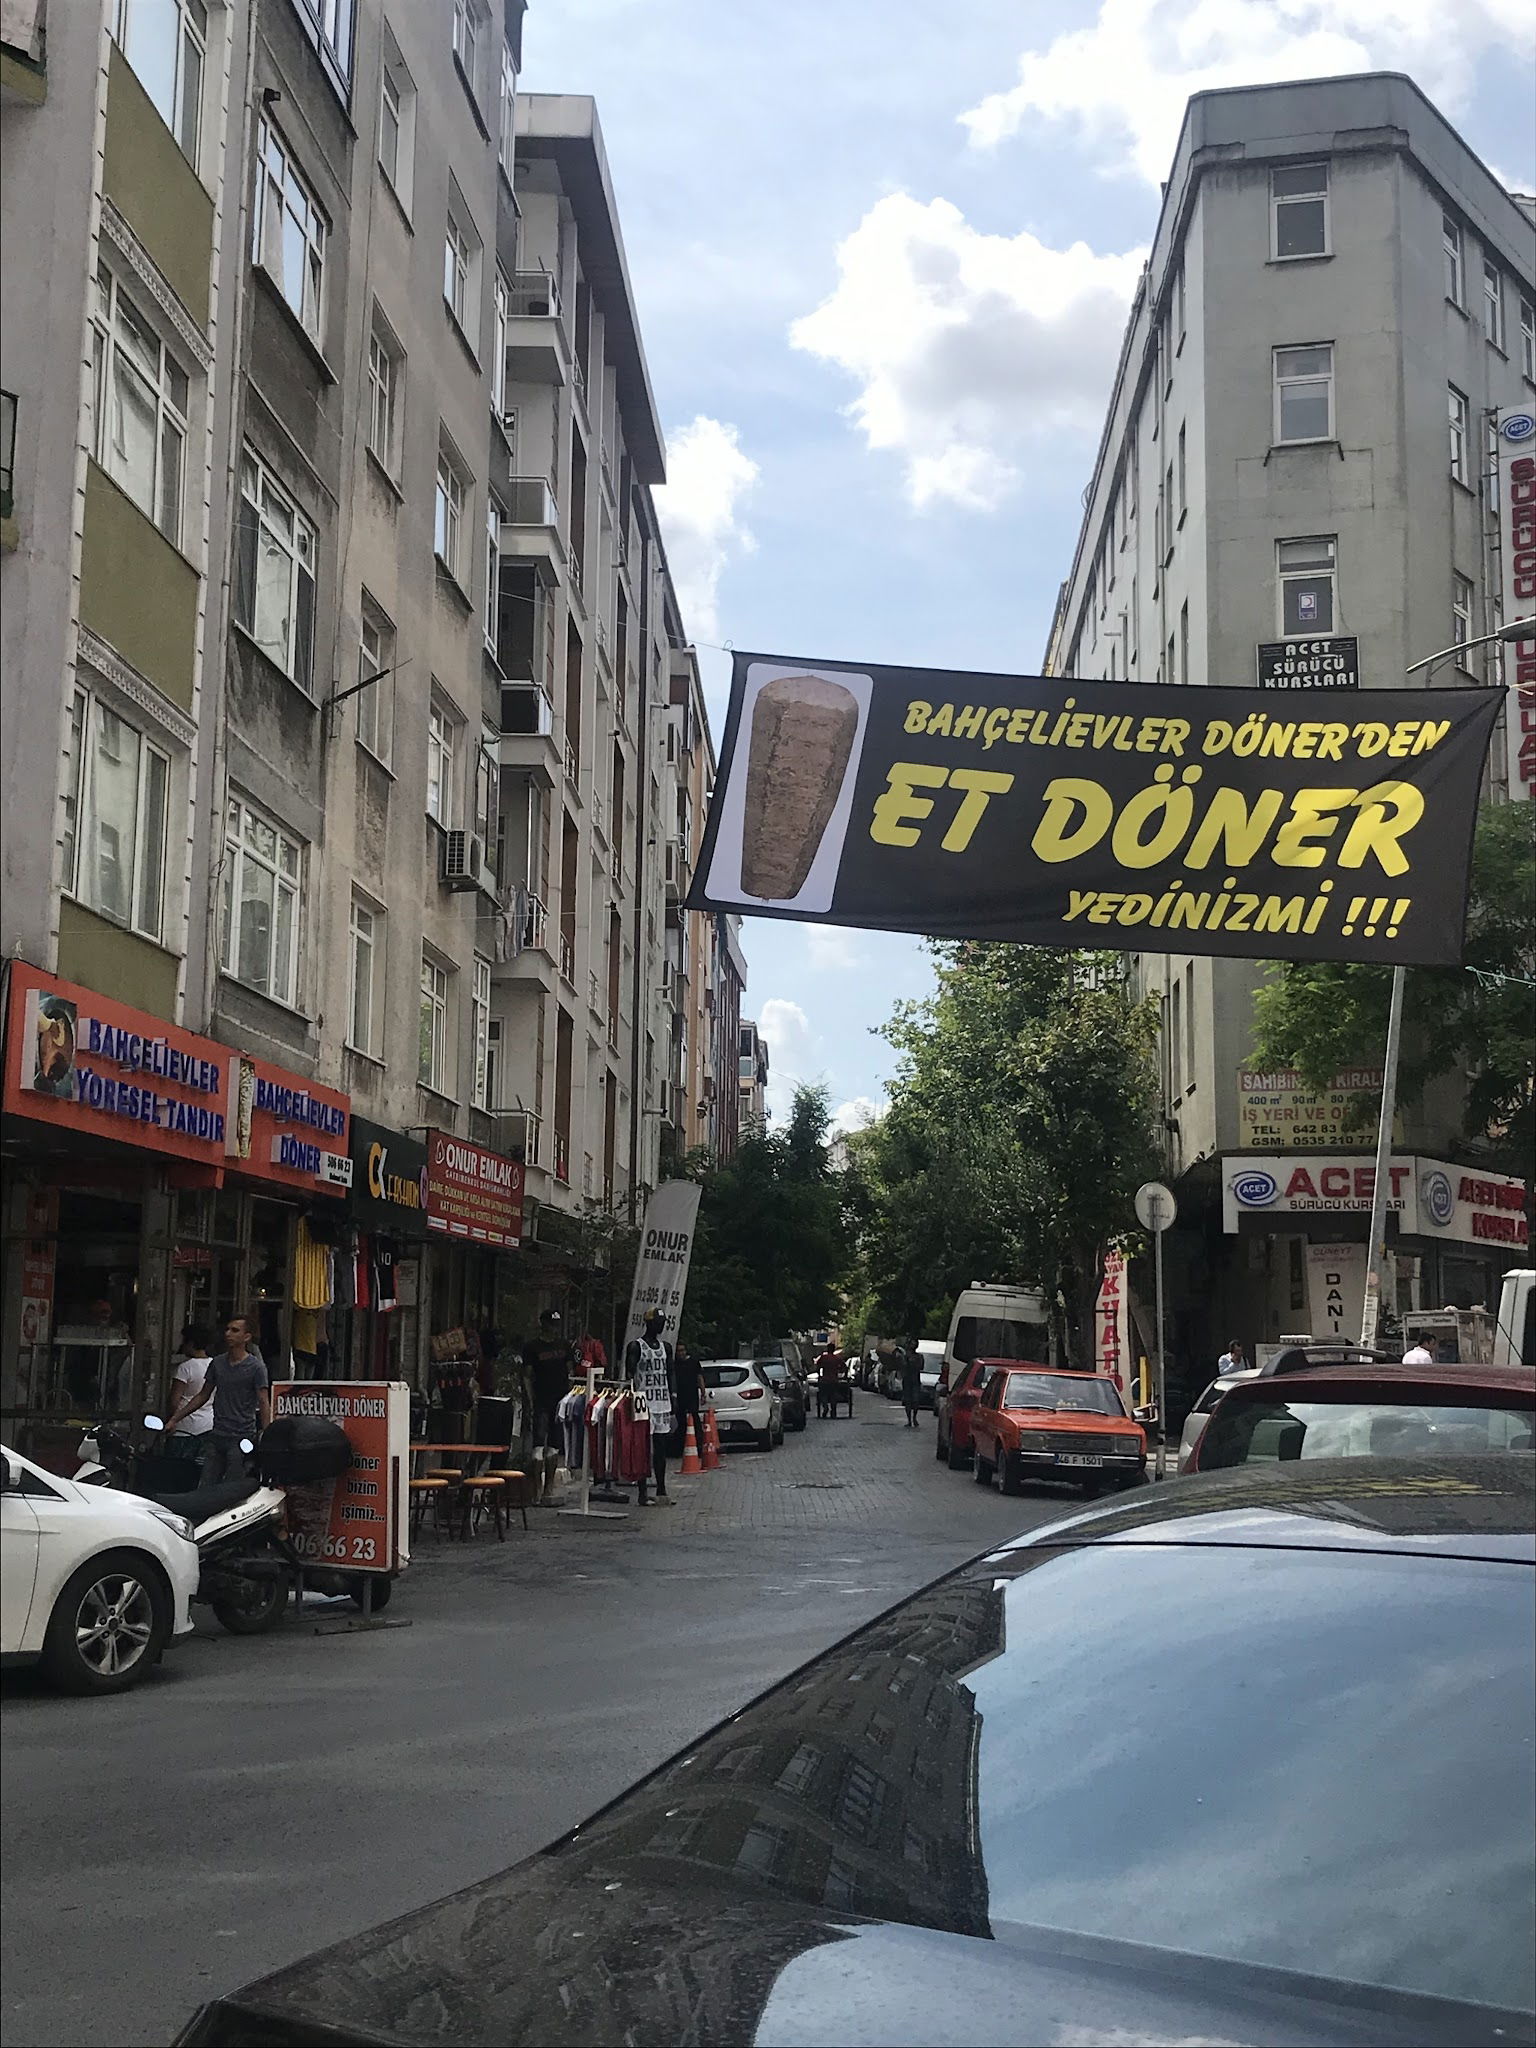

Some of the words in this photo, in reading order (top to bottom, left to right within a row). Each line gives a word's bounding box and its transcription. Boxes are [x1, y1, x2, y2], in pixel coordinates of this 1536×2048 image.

[1285, 641, 1331, 656] ACET
[1273, 654, 1345, 675] SÜRÜCÜ
[1264, 671, 1354, 688] KURSLARI
[904, 697, 1191, 757] BAHÇELİEVLER
[1202, 713, 1450, 761] DÖNER'DEN
[870, 762, 1014, 852] ET
[1031, 763, 1425, 877] DÖNER
[1061, 876, 1334, 935] YEDİNİZMİ
[1341, 897, 1411, 938] !!!
[89, 1017, 220, 1094] BAHÇELİEVLER
[1243, 1074, 1331, 1090] SAHİBİN
[1336, 1071, 1384, 1088] KİRALI
[256, 1078, 345, 1136] BAHÇELİEVLER
[1248, 1096, 1267, 1105] 400
[167, 1098, 224, 1142] TANDIR
[1242, 1107, 1258, 1124] İŞ
[1263, 1105, 1300, 1121] YERİ
[1305, 1107, 1326, 1120] VE
[1252, 1126, 1281, 1135] TEL:
[1292, 1125, 1317, 1134] 642
[1321, 1125, 1337, 1134] 83
[1251, 1137, 1285, 1146] GSM:
[1293, 1136, 1325, 1146] 0535
[1330, 1136, 1354, 1145] 210
[1358, 1136, 1374, 1145] 77
[281, 1133, 320, 1174] DÖNER
[446, 1143, 478, 1176] ONUR
[480, 1155, 512, 1187] EMLAK
[1242, 1184, 1267, 1194] ACET
[1284, 1167, 1410, 1199] ACET
[1289, 1197, 1342, 1210] SÜRÜCÜ
[1344, 1199, 1406, 1210] KURSARI
[646, 1230, 690, 1252] ONUR
[643, 1249, 686, 1265] EMLAK
[670, 1290, 680, 1307] 55
[353, 1394, 385, 1418] DÖNER
[290, 1533, 318, 1554] 06
[322, 1535, 347, 1558] 66
[352, 1537, 376, 1561] 23
